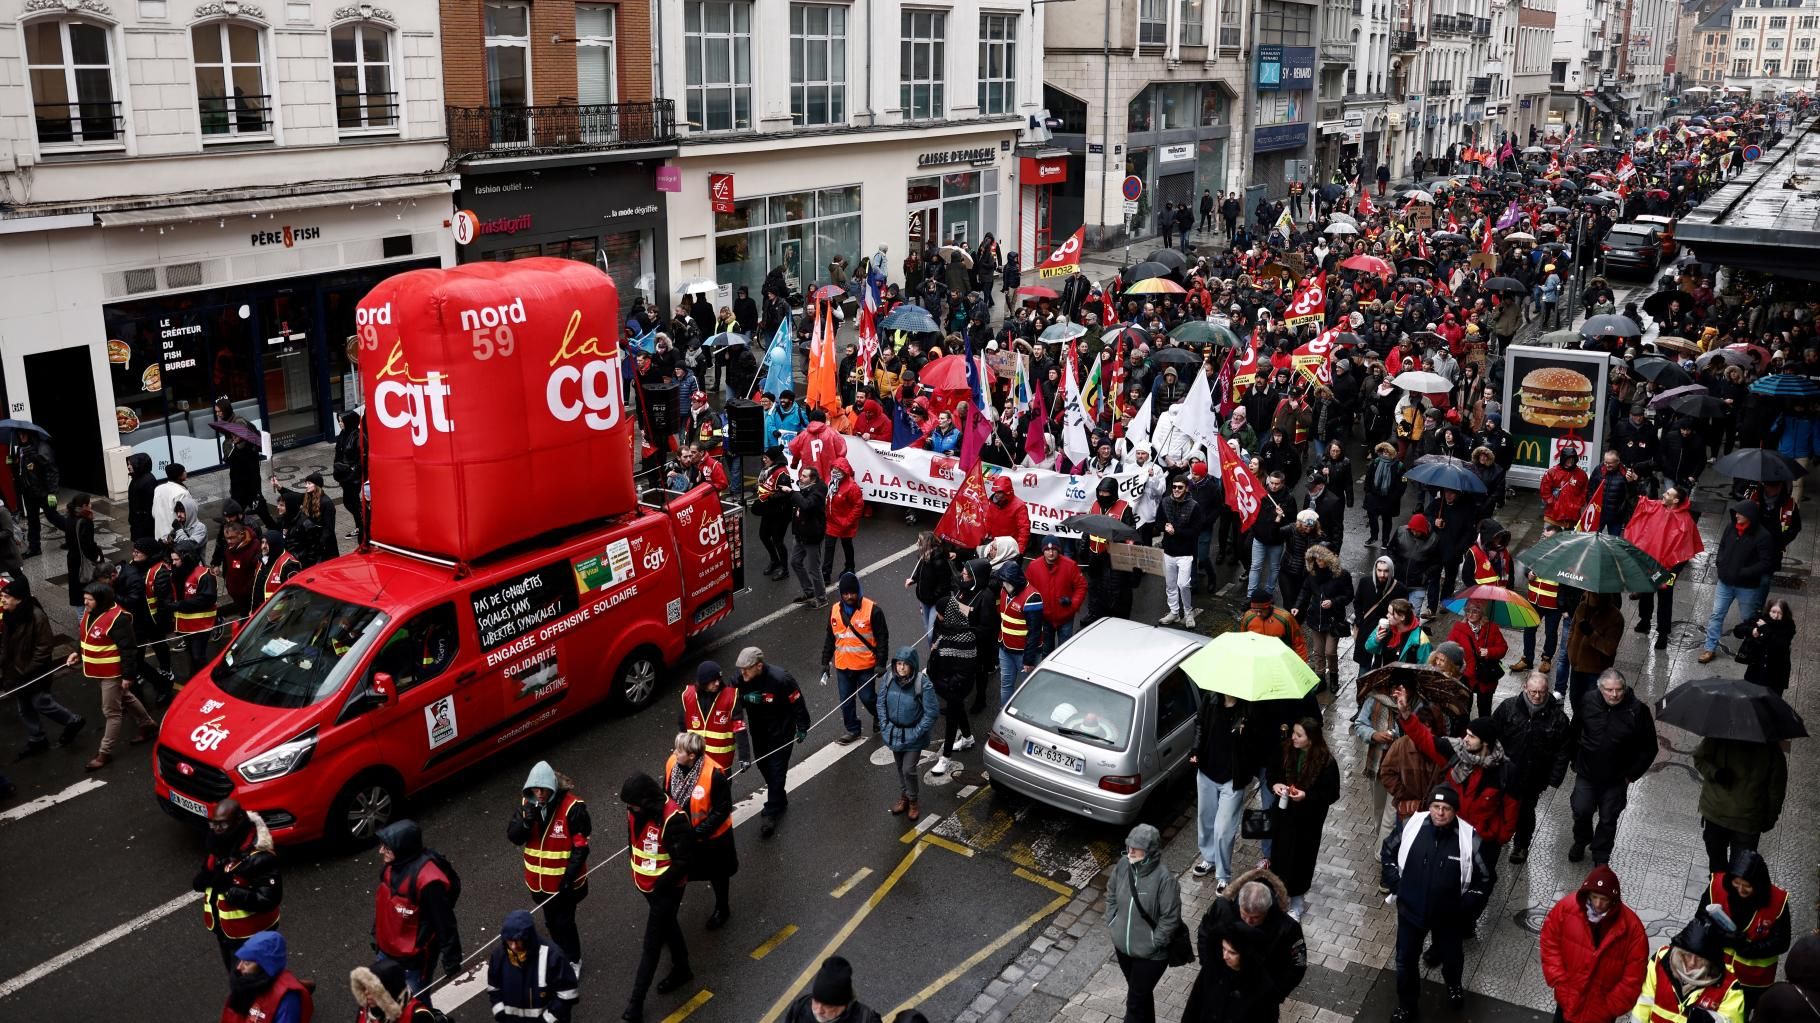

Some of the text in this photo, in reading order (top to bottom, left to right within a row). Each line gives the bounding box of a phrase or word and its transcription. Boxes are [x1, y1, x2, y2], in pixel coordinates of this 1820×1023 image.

[1293, 67, 1312, 79] RENARD
[918, 150, 949, 165] CAISSE
[475, 184, 500, 195] fashion
[502, 182, 522, 192] outlet
[618, 206, 634, 217] mode
[634, 203, 659, 216] dégriffée
[251, 231, 283, 247] PÈRE
[293, 226, 320, 241] FISH
[160, 319, 171, 328] LE
[356, 302, 391, 326] ord
[460, 297, 527, 331] nord
[161, 324, 202, 339] CRÉATEUR
[549, 309, 622, 367] la
[162, 340, 174, 350] DU
[472, 325, 515, 361] 59
[164, 350, 182, 361] FISH
[165, 358, 196, 372] BURGER
[374, 371, 455, 447] cgt
[811, 438, 823, 462] P
[874, 448, 905, 459] Solidaires
[938, 467, 954, 479] cgt
[1119, 475, 1140, 493] CFE
[861, 469, 873, 484] À
[880, 474, 901, 488] LA
[906, 480, 958, 500] CASSE
[1065, 487, 1086, 500] cftc
[1130, 483, 1146, 498] CG
[676, 504, 694, 519] nord
[680, 514, 692, 527] 59
[869, 489, 918, 504] JUSTE
[1029, 520, 1050, 532] ES
[699, 514, 725, 545] cgt
[643, 546, 665, 570] cgt
[1557, 570, 1584, 582] JAGUAR
[473, 574, 543, 614] PAS DE CONQUÊTES
[478, 597, 531, 631] SOCIALES SANS
[482, 621, 516, 647] LIBERTÉS
[517, 603, 556, 631] SYNDICALES
[486, 585, 638, 668] ENGAGÉE OFFENSIVE SOLIDAIRE
[503, 644, 557, 679] SOLIDARITÉ
[534, 675, 567, 700] PALESTINE
[190, 725, 231, 752] cgt
[1033, 745, 1076, 769] GK-633-ZK
